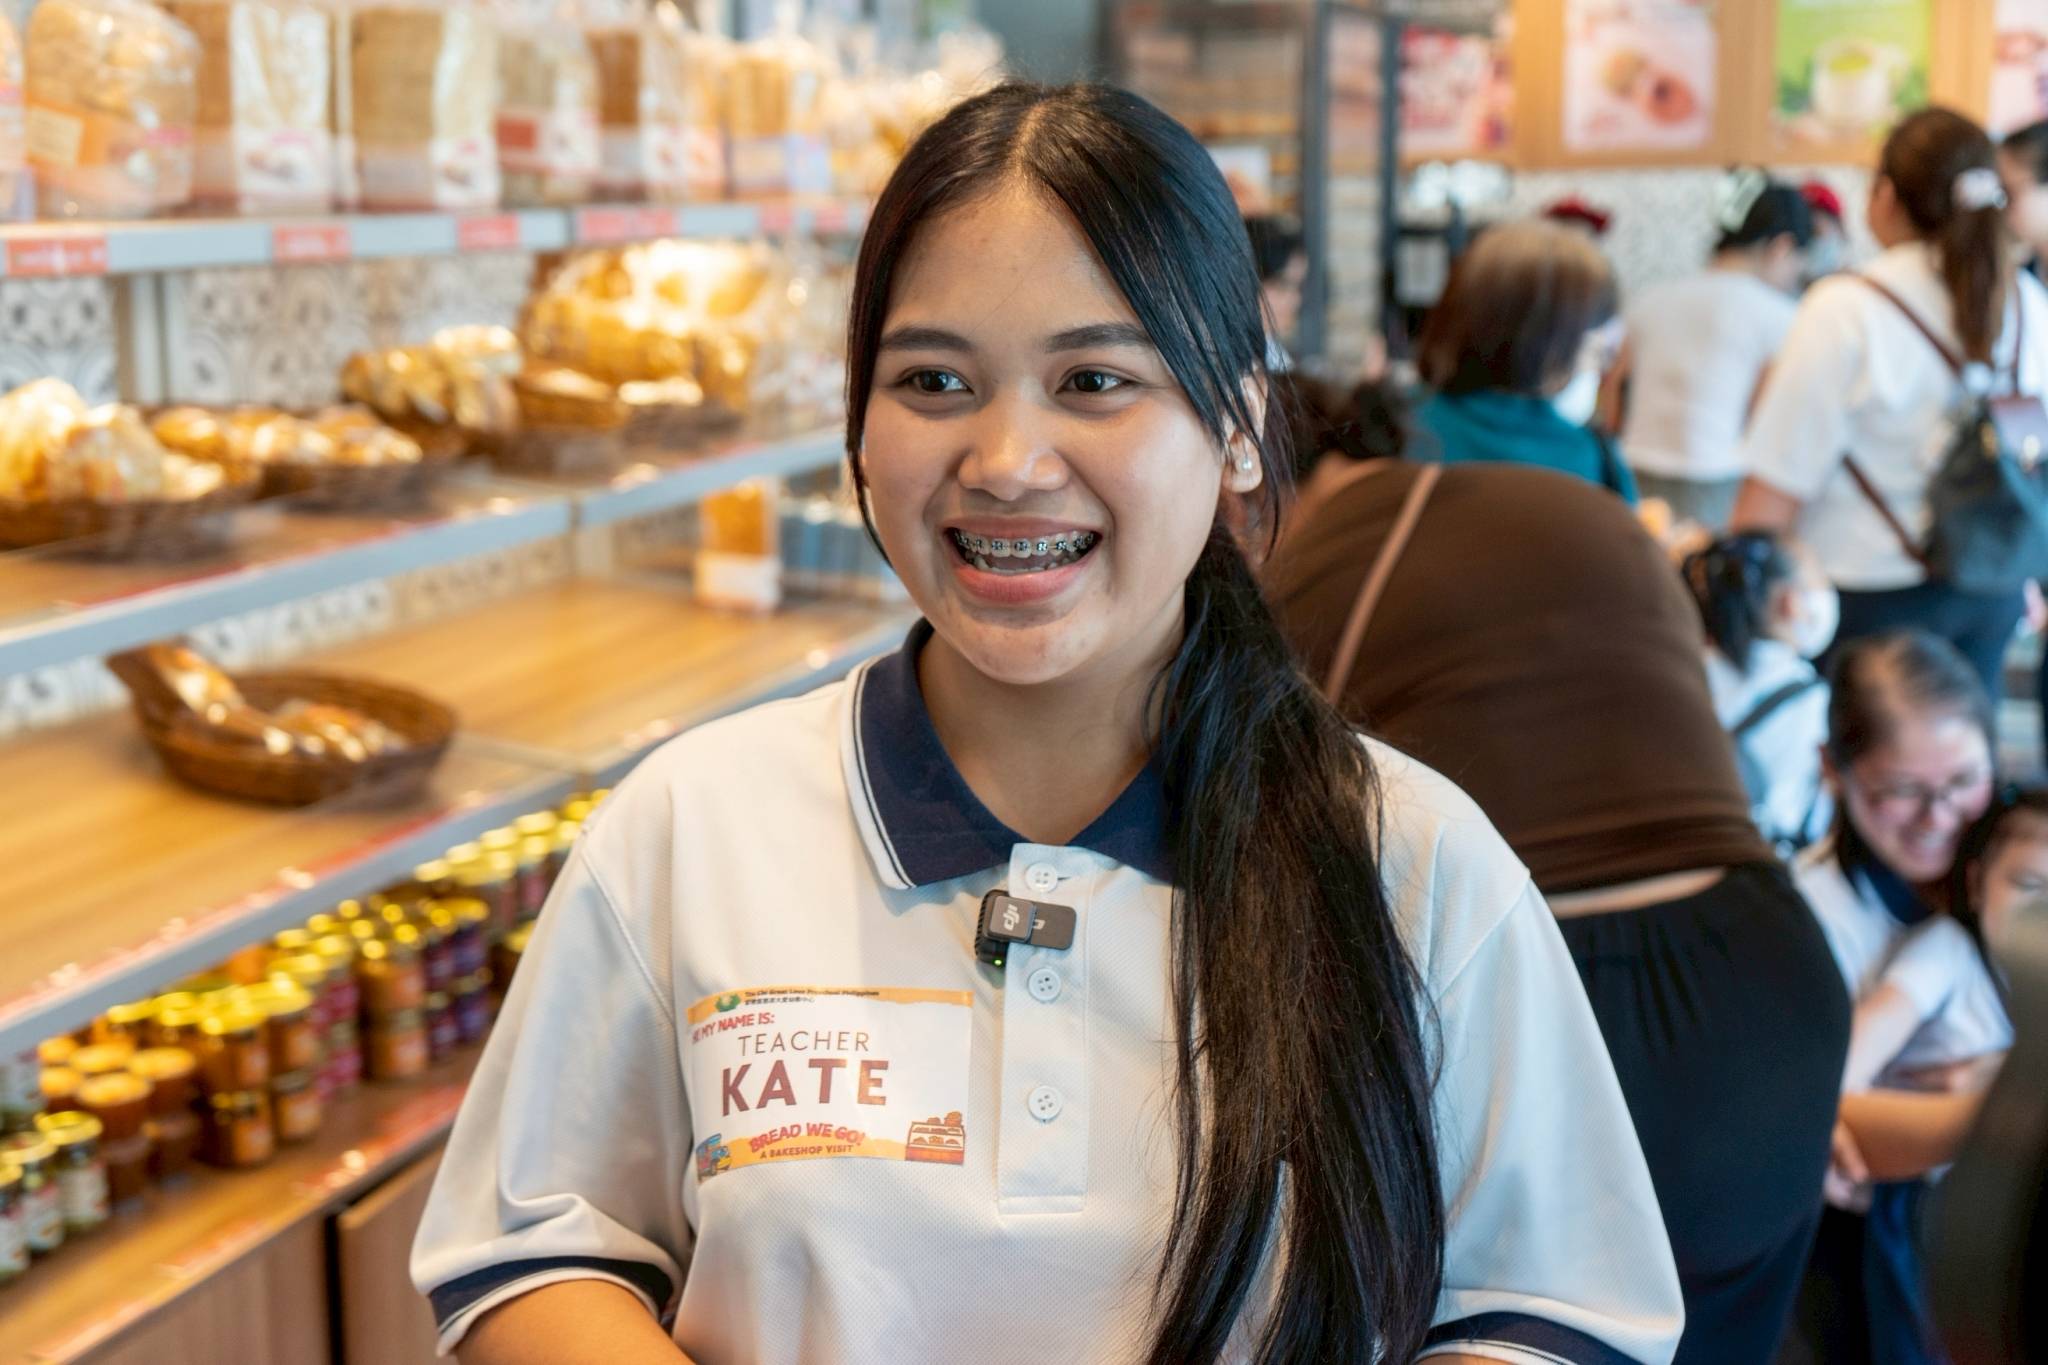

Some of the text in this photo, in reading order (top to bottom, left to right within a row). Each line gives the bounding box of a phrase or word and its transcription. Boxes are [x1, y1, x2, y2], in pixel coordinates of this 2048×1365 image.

[702, 1022, 716, 1038] MY
[718, 1014, 754, 1032] NAME
[758, 1012, 775, 1025] IS:
[738, 1031, 870, 1056] TEACHER
[722, 1058, 889, 1117] KATE
[749, 1122, 866, 1152] BREAD WE GO!
[760, 1144, 855, 1159] A BAKESHOP VISIT
